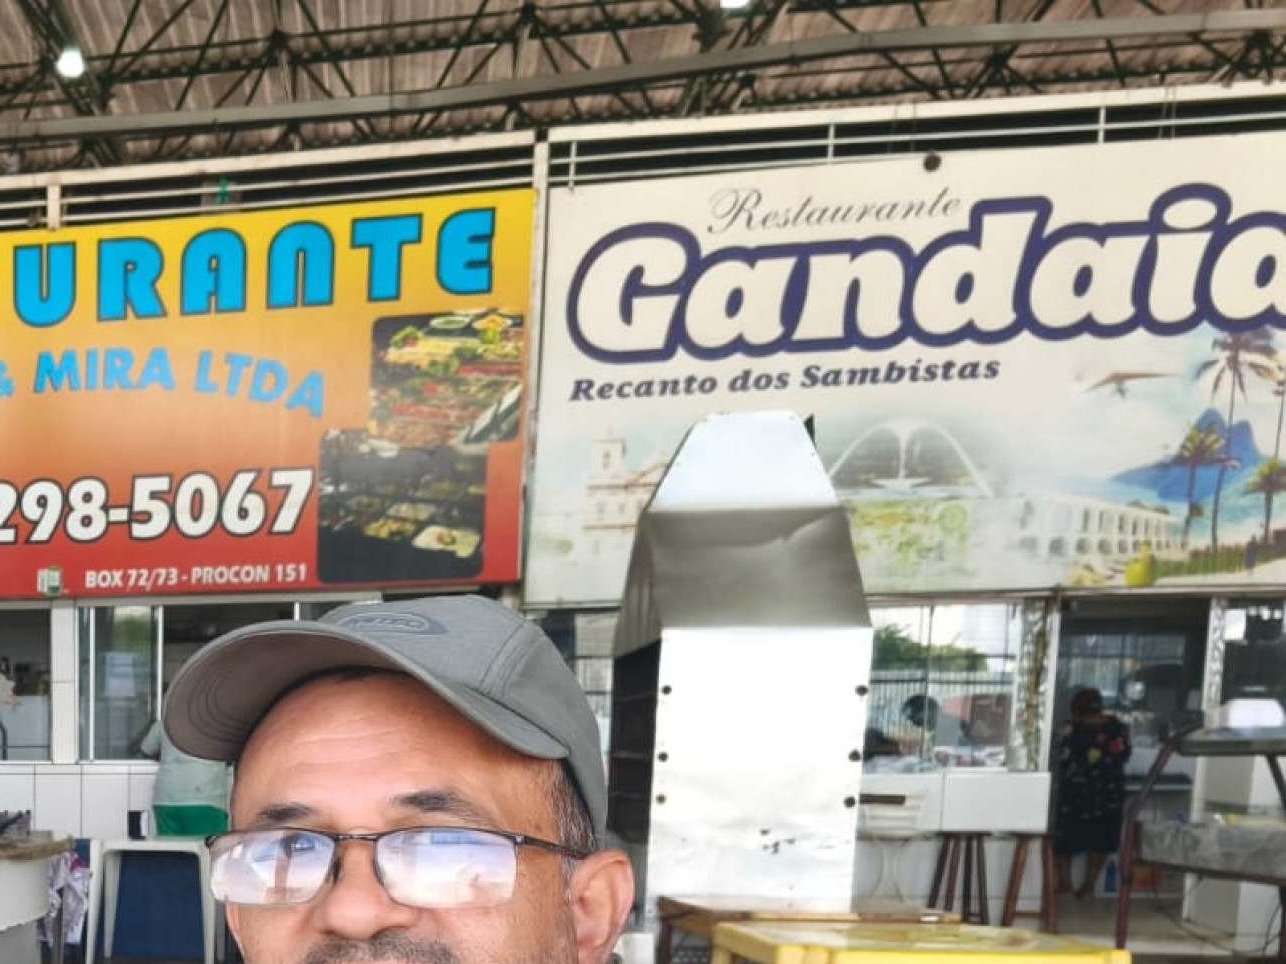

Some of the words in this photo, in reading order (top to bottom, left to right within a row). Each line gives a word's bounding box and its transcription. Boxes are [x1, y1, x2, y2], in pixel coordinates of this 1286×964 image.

[707, 187, 961, 233] Restaurante
[33, 347, 175, 394] MIRA
[195, 349, 325, 419] LTDA
[568, 373, 718, 401] Recanto
[728, 367, 790, 393] dos
[800, 358, 1002, 388] Sambistas
[84, 570, 123, 588] BOX
[127, 567, 178, 591] 72/73
[191, 565, 269, 584] PROCON
[276, 563, 307, 582] 151
